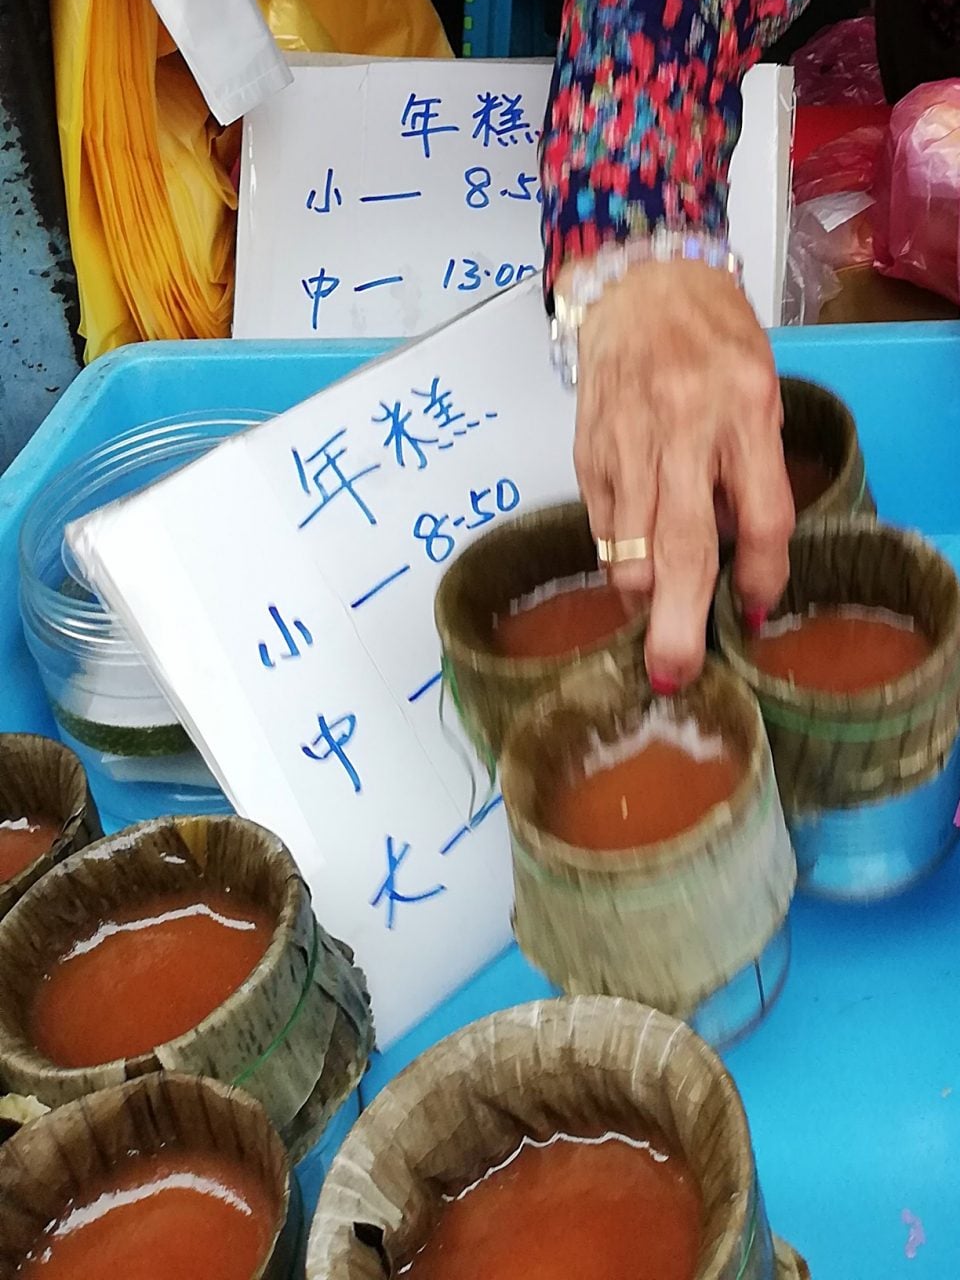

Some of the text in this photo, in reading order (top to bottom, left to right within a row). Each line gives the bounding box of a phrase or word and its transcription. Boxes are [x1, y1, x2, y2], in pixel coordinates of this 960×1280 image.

[400, 93, 540, 158] 年糕
[306, 169, 342, 213] 小
[302, 267, 340, 330] 中
[291, 375, 499, 530] 年糕
[257, 603, 314, 668] 小
[301, 713, 361, 793] 中
